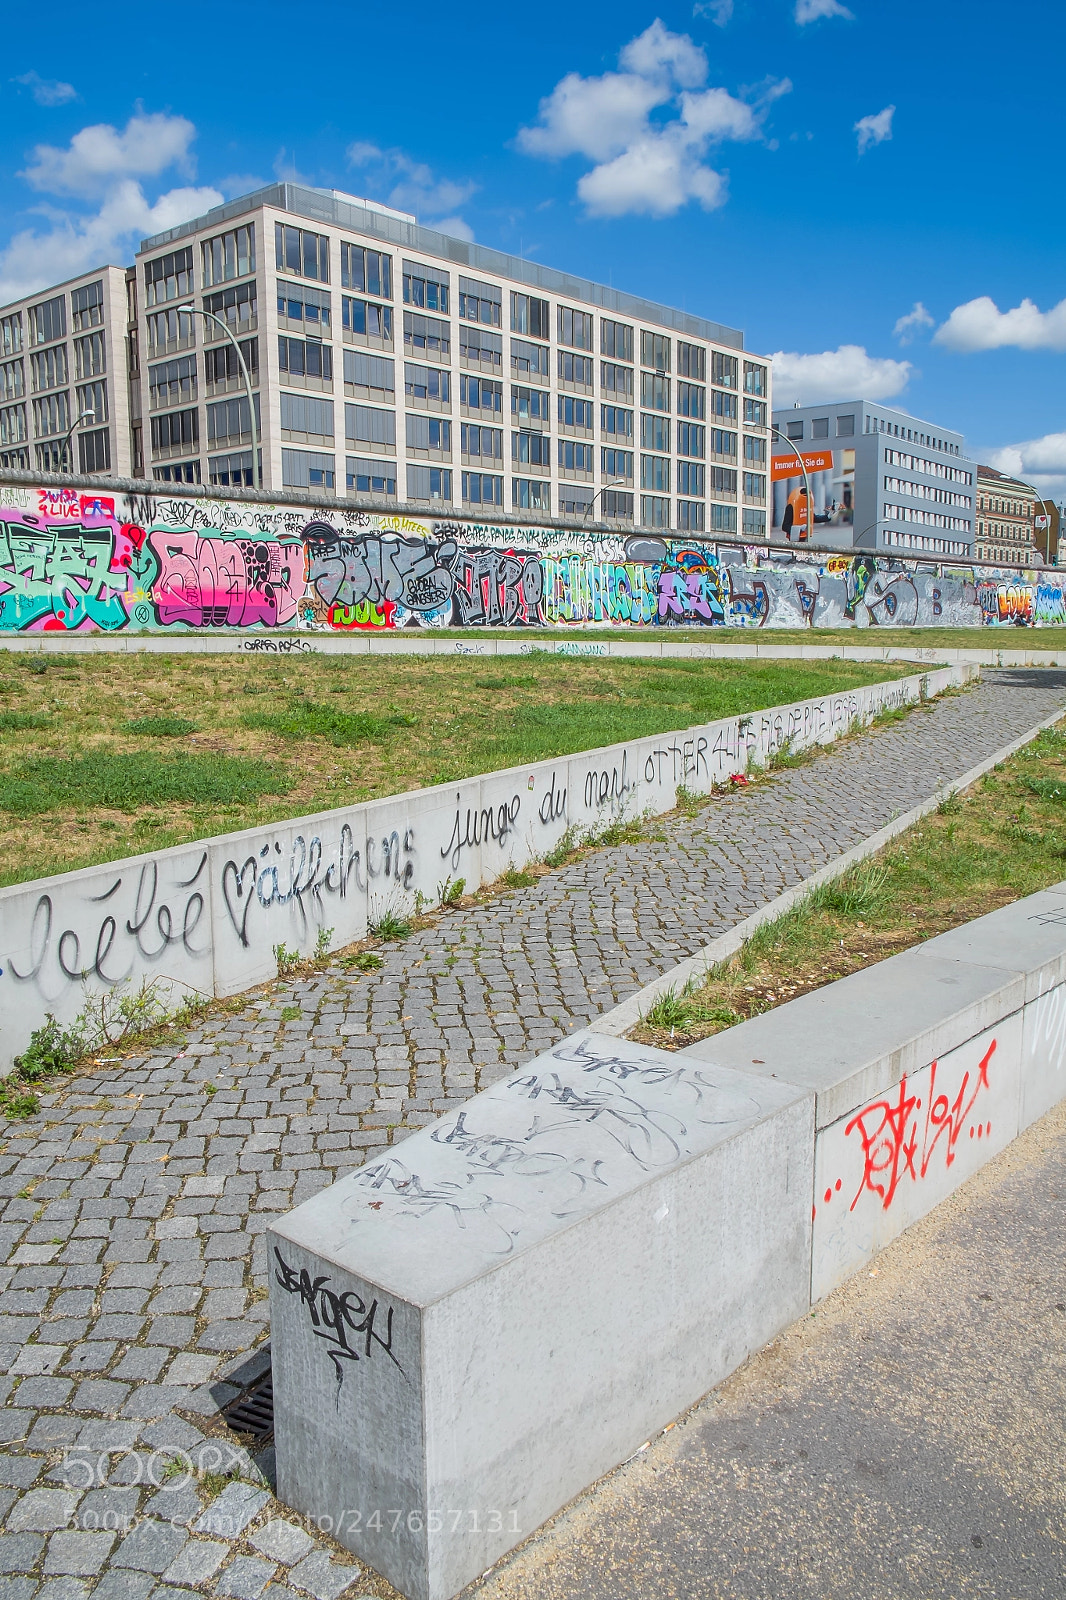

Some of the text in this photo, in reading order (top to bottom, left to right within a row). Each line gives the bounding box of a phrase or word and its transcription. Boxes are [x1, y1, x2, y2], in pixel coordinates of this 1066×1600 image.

[775, 461, 794, 470] Immer
[805, 458, 815, 467] Sie
[816, 458, 824, 466] da
[538, 772, 567, 825] du
